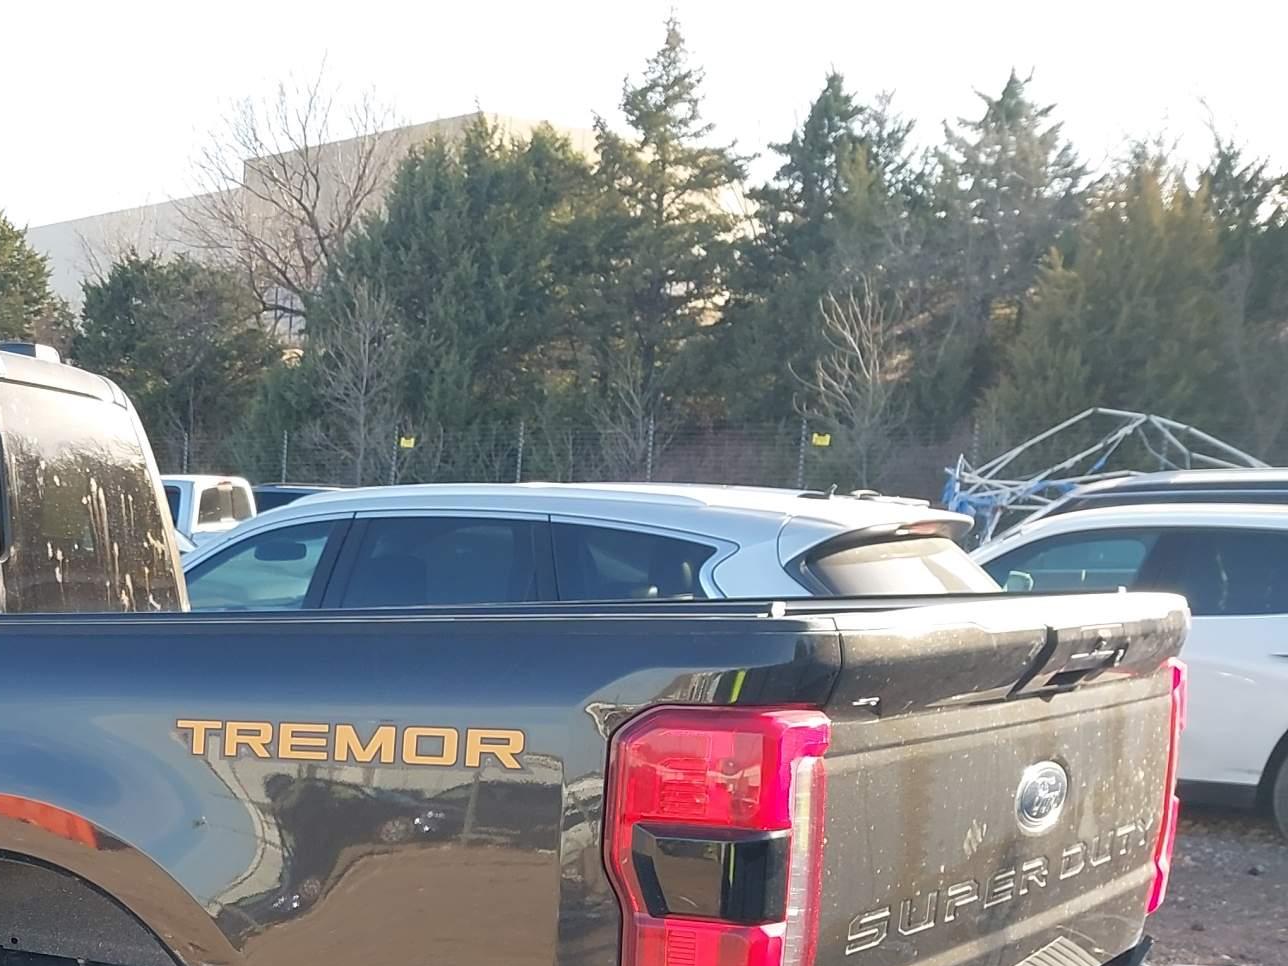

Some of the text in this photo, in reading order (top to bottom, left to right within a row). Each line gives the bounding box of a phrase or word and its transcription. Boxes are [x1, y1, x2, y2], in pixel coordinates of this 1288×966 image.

[176, 719, 526, 770] TREMOR
[845, 816, 1154, 955] SUPER DUTY
